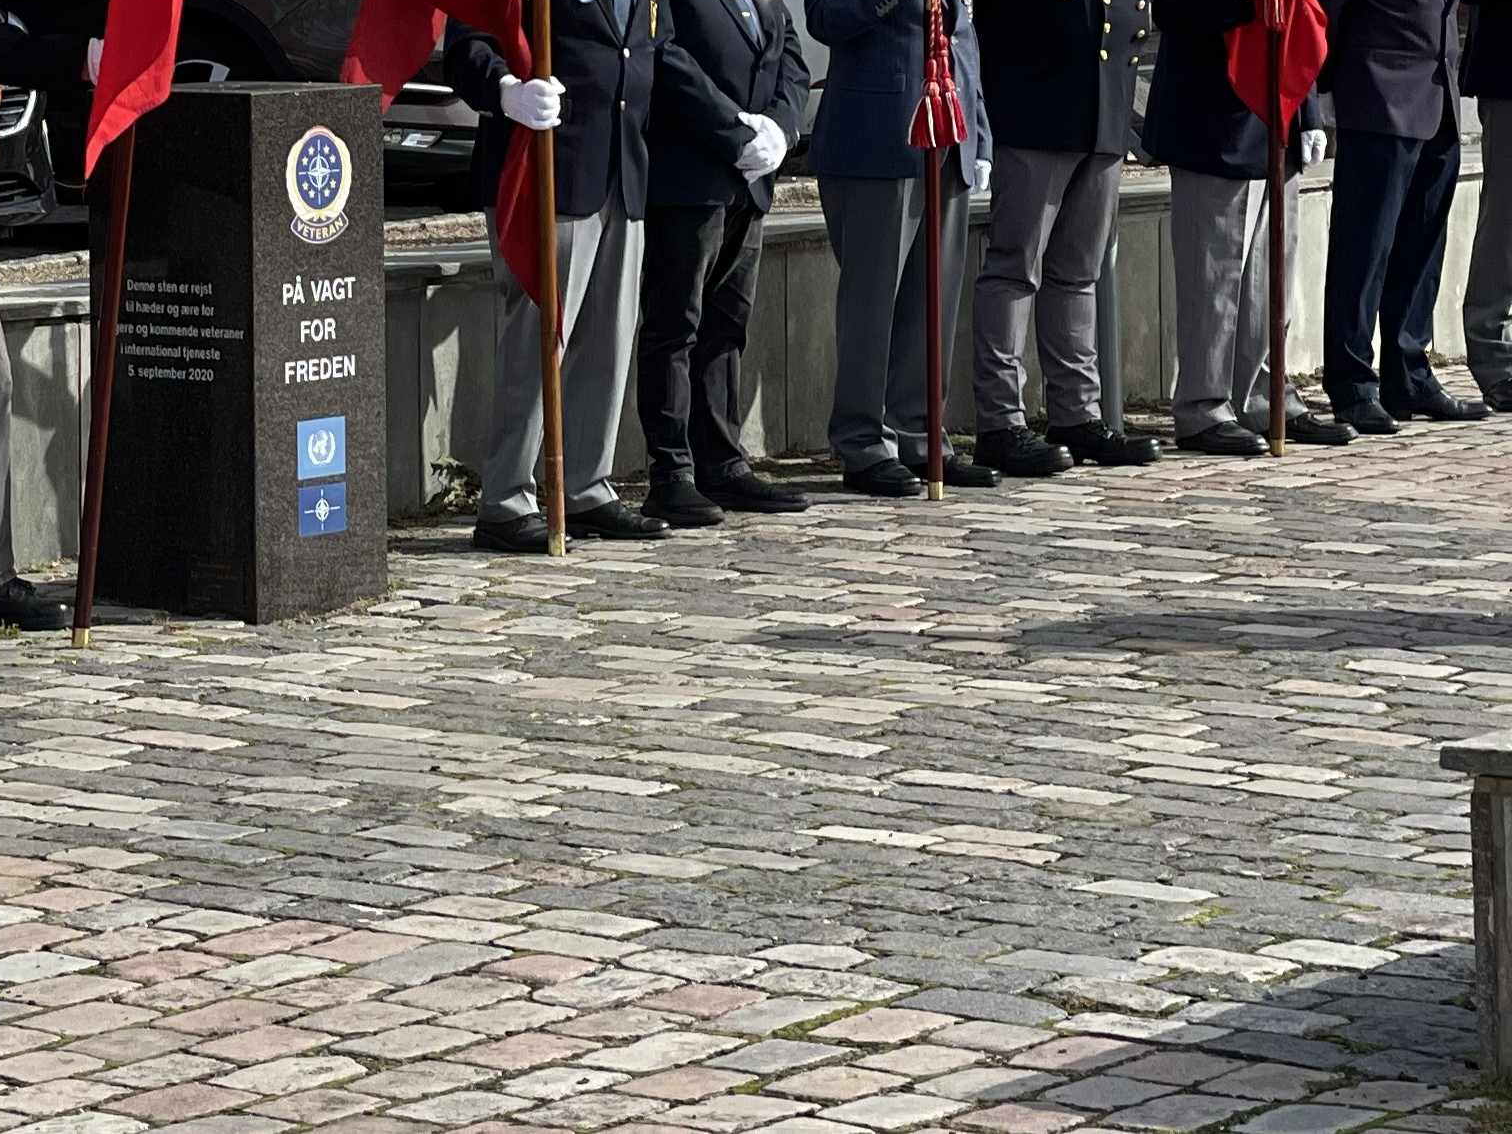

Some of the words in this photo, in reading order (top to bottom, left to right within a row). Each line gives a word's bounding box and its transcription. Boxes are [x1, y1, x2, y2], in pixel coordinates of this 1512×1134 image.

[297, 216, 345, 241] VETERAN
[126, 279, 155, 292] Denne
[157, 280, 178, 293] sten
[179, 283, 189, 294] er
[190, 282, 213, 297] rejst
[282, 275, 306, 305] PÅ
[310, 277, 356, 302] VAGT
[125, 300, 135, 312] til
[135, 301, 165, 314] hæder
[166, 305, 180, 318] og
[181, 306, 199, 316] ære
[201, 303, 215, 317] for
[136, 324, 148, 338] og
[149, 323, 199, 338] kommende
[200, 326, 245, 340] veteraner
[300, 318, 336, 343] FOR
[124, 342, 181, 358] international
[182, 346, 221, 362] tjeneste
[137, 366, 187, 380] september
[188, 368, 214, 382] 2020
[284, 355, 356, 385] FREDEN
